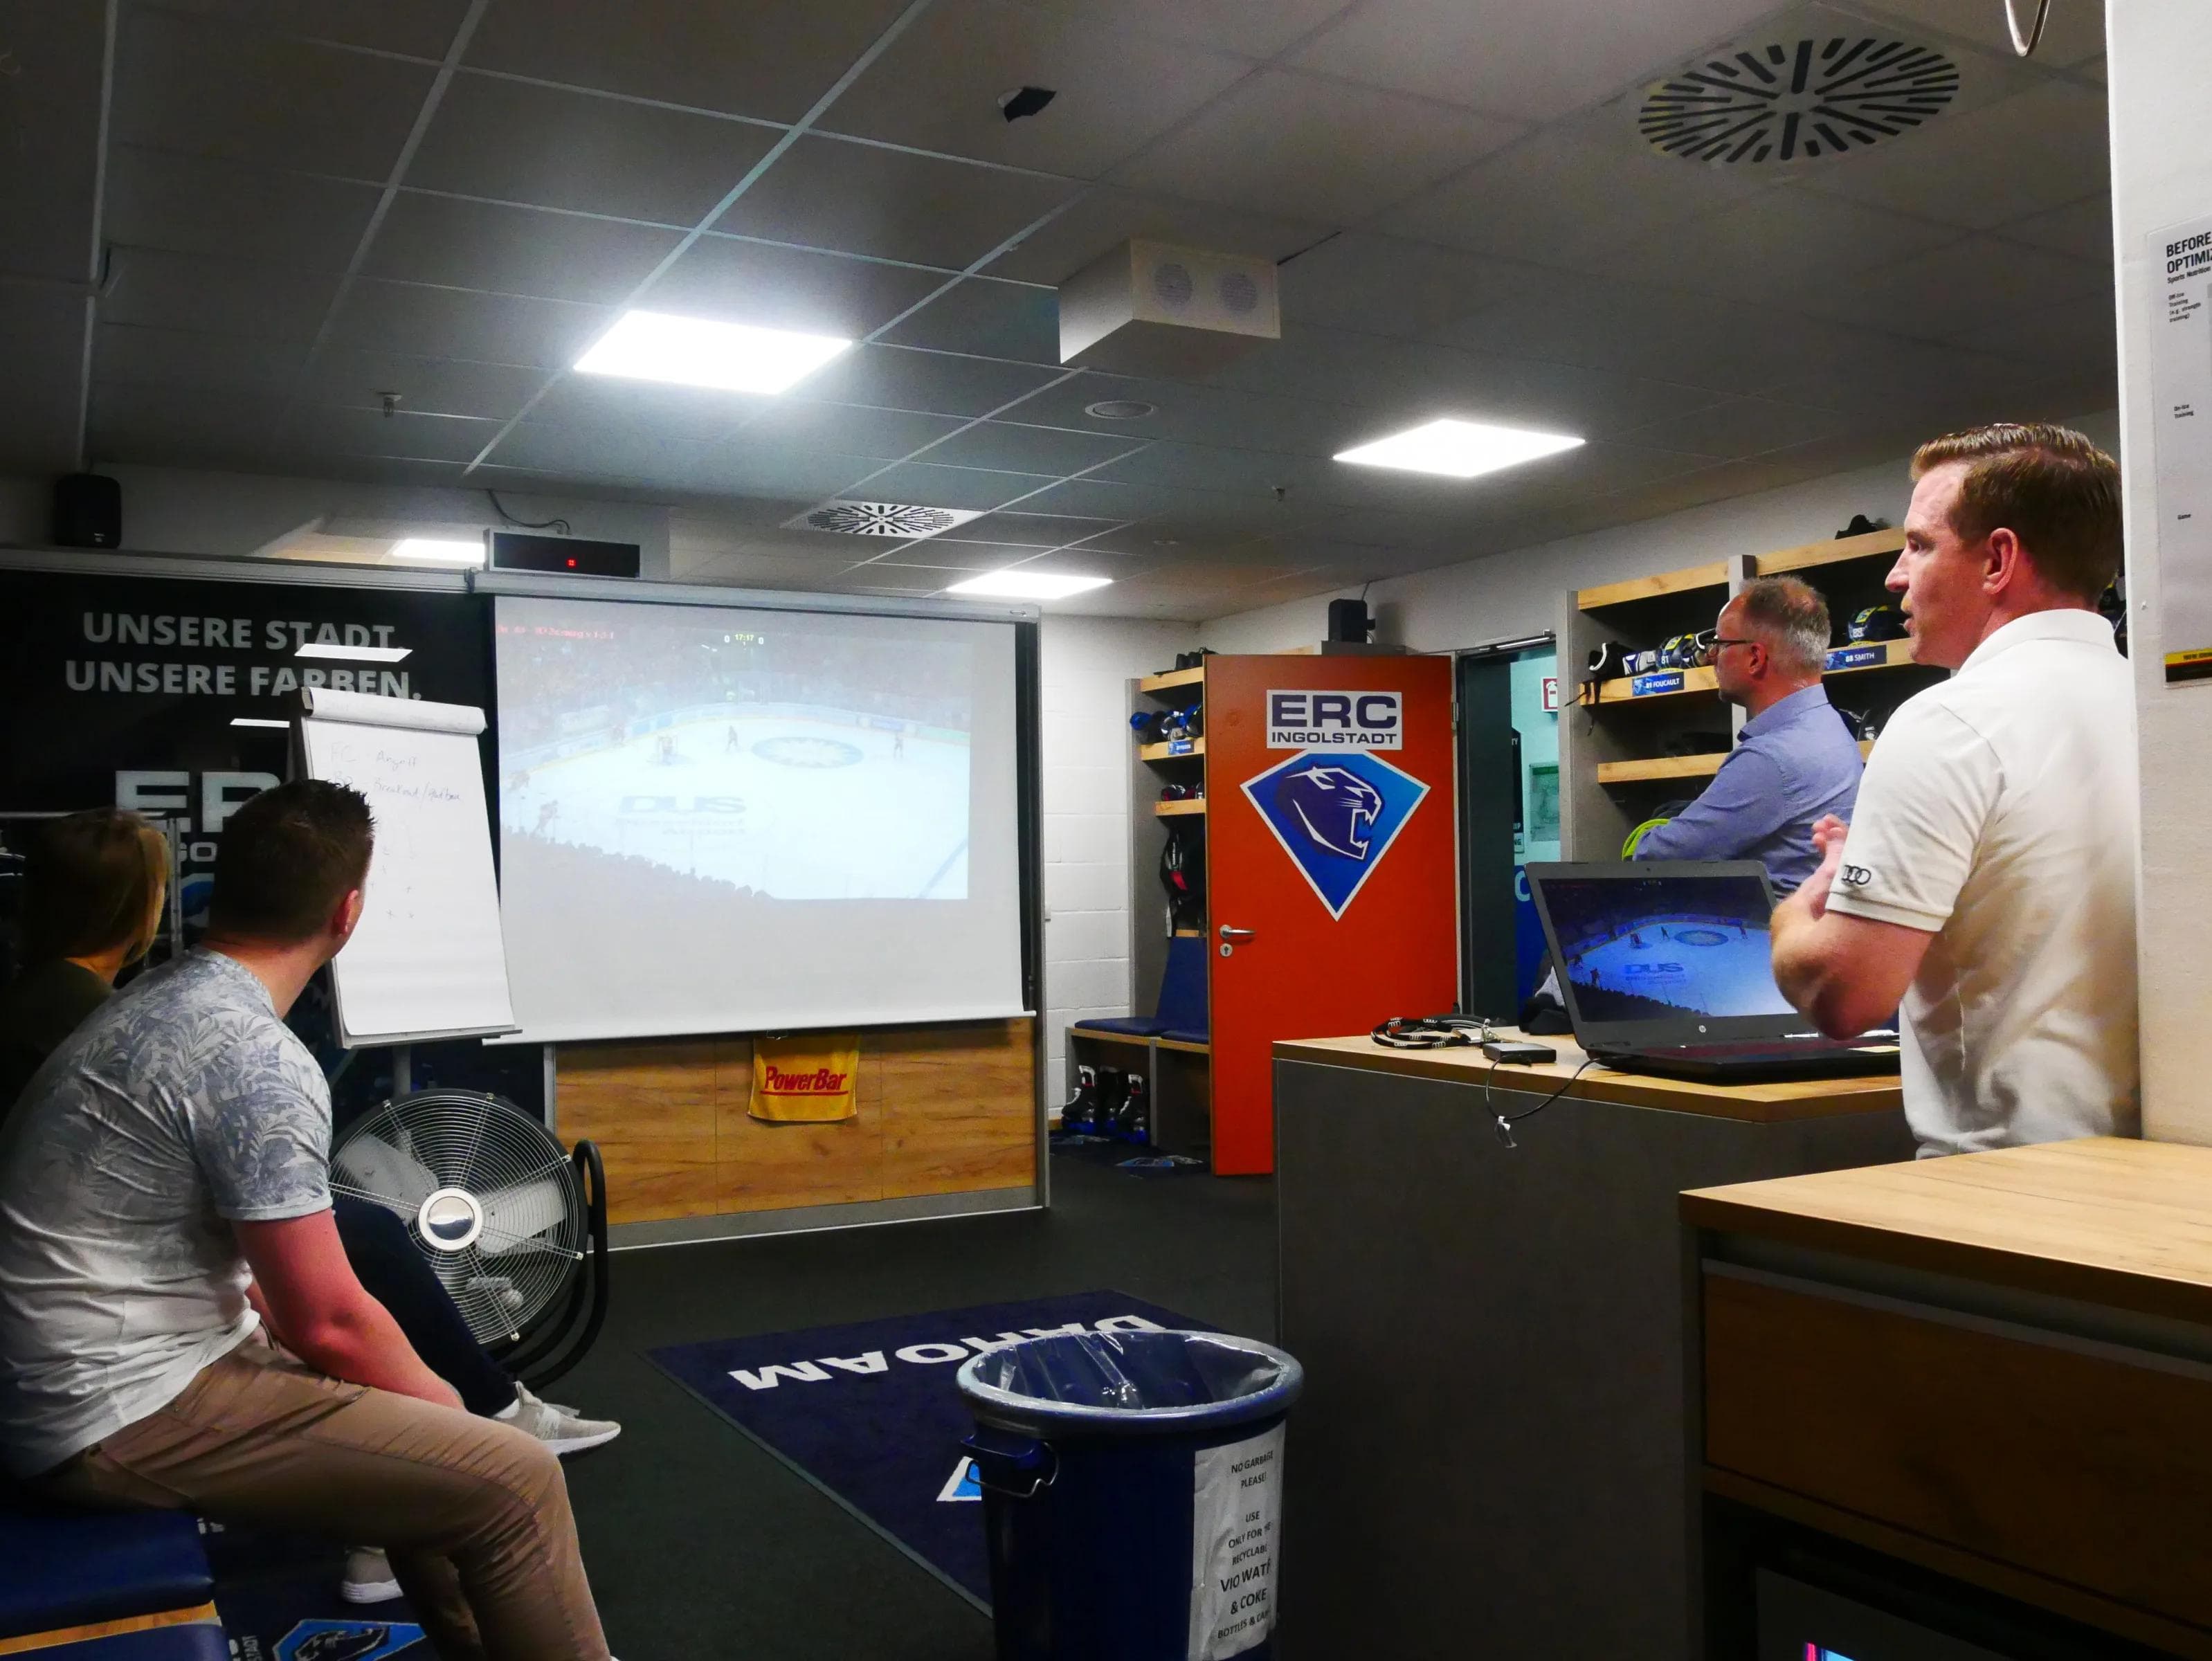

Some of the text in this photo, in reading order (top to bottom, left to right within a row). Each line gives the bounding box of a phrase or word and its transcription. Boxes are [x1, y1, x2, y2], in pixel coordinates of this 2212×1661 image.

[2166, 231, 2211, 257] BEFORE
[2167, 266, 2211, 284] Sports Nutrition
[83, 612, 252, 648] UNSERE
[724, 635, 730, 643] 0
[758, 637, 764, 645] 0
[1854, 652, 1875, 662] SMITH
[66, 660, 421, 700] UNSERE FARBEN.
[1653, 678, 1680, 688] FOUCAULT
[1272, 694, 1397, 729] ERC
[1272, 732, 1397, 744] INGOLSTADT
[764, 1066, 847, 1091] PowerBar
[1231, 1450, 1273, 1473] NO GARBAGE
[1246, 1510, 1260, 1523] USE
[1229, 1533, 1246, 1549] ONLY
[1246, 1527, 1262, 1540] FOR
[1220, 1574, 1240, 1592] VIO
[1231, 1588, 1268, 1615] & COKE
[1217, 1619, 1247, 1639] BOTTLES
